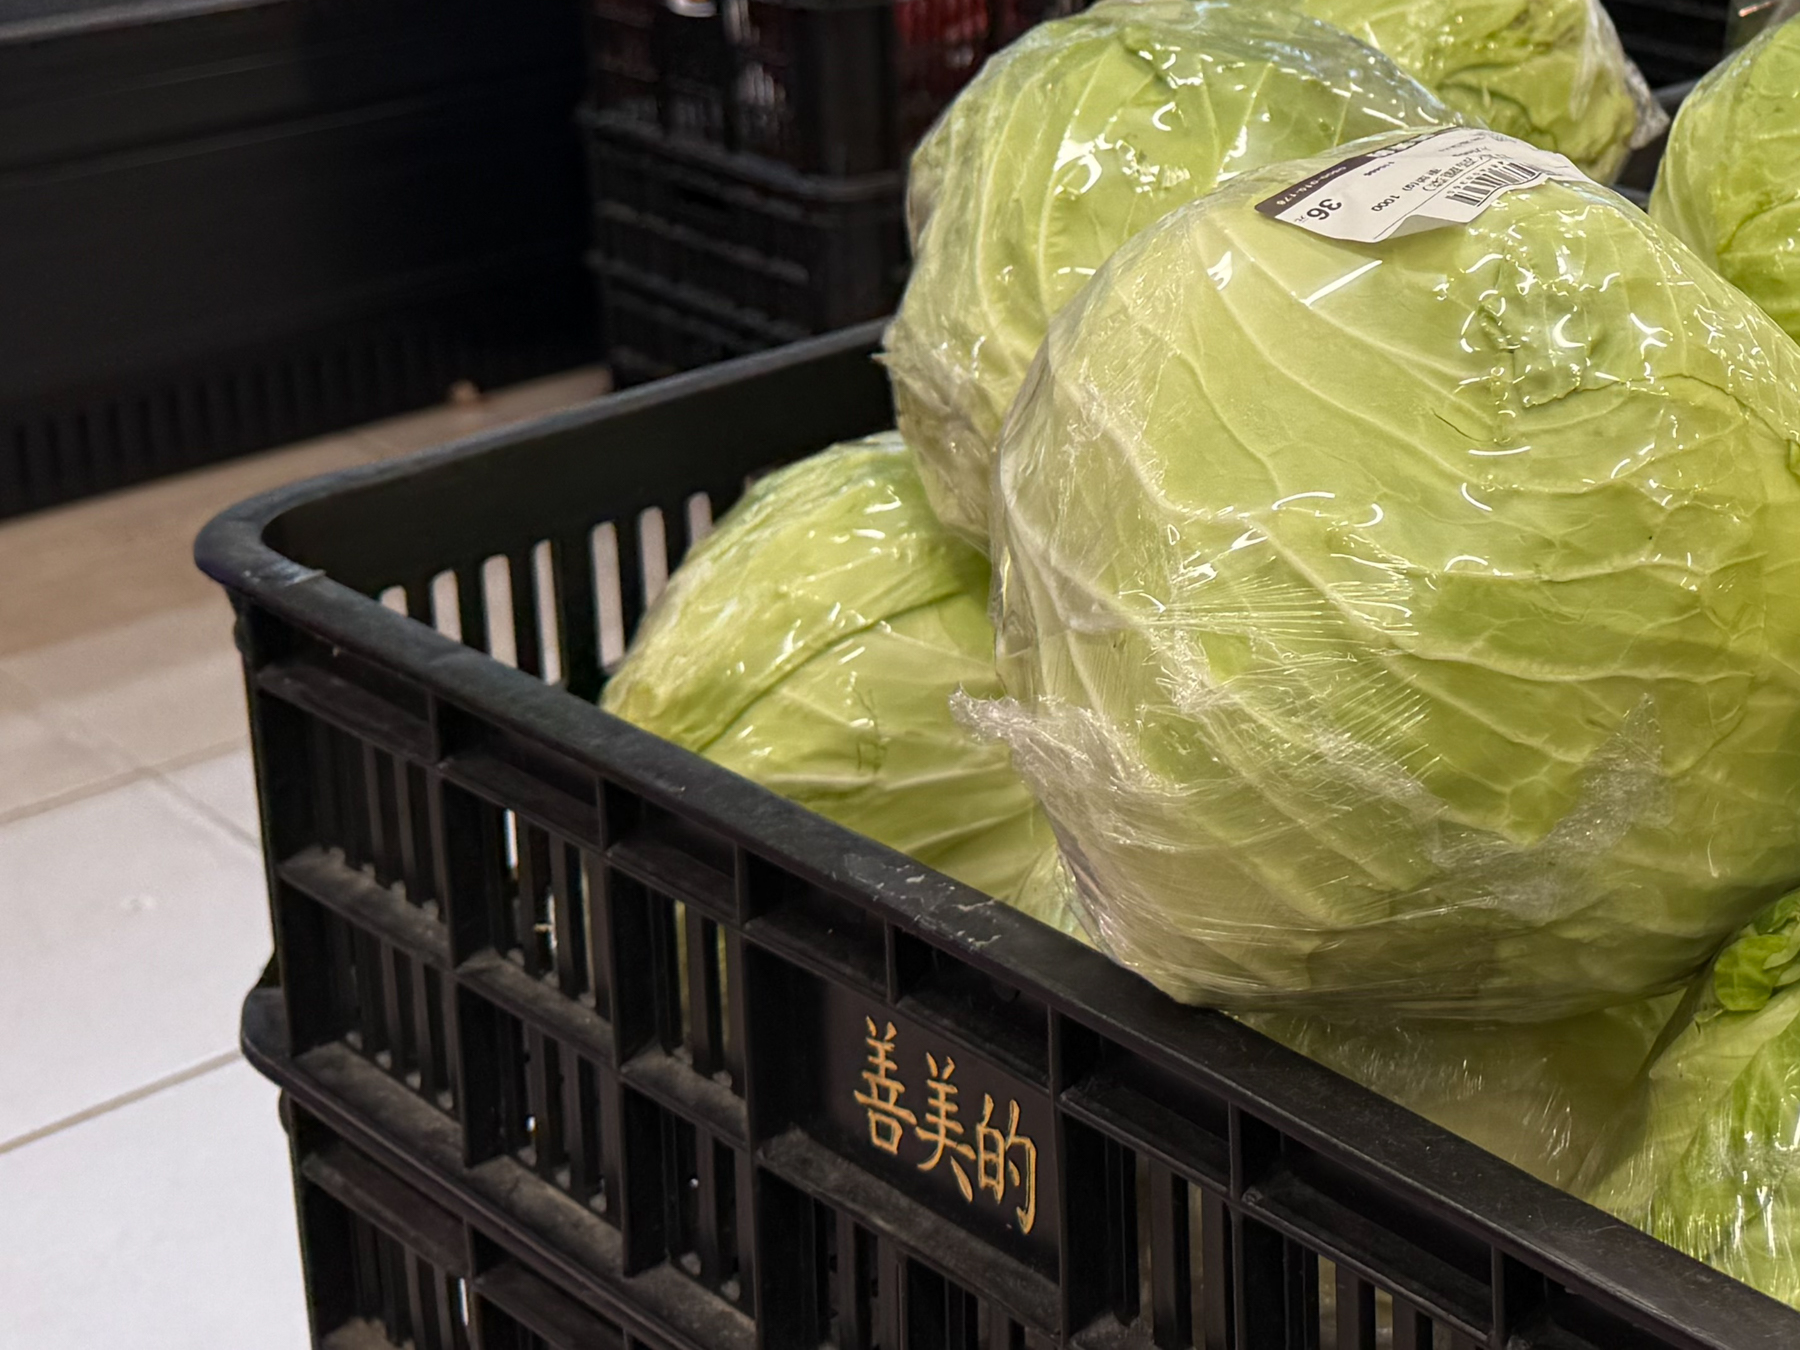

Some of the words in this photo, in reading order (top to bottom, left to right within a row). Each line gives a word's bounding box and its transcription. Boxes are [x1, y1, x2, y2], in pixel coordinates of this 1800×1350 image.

[1306, 198, 1342, 221] 36
[1371, 194, 1401, 212] 1000
[853, 1015, 1037, 1235] 善美的
